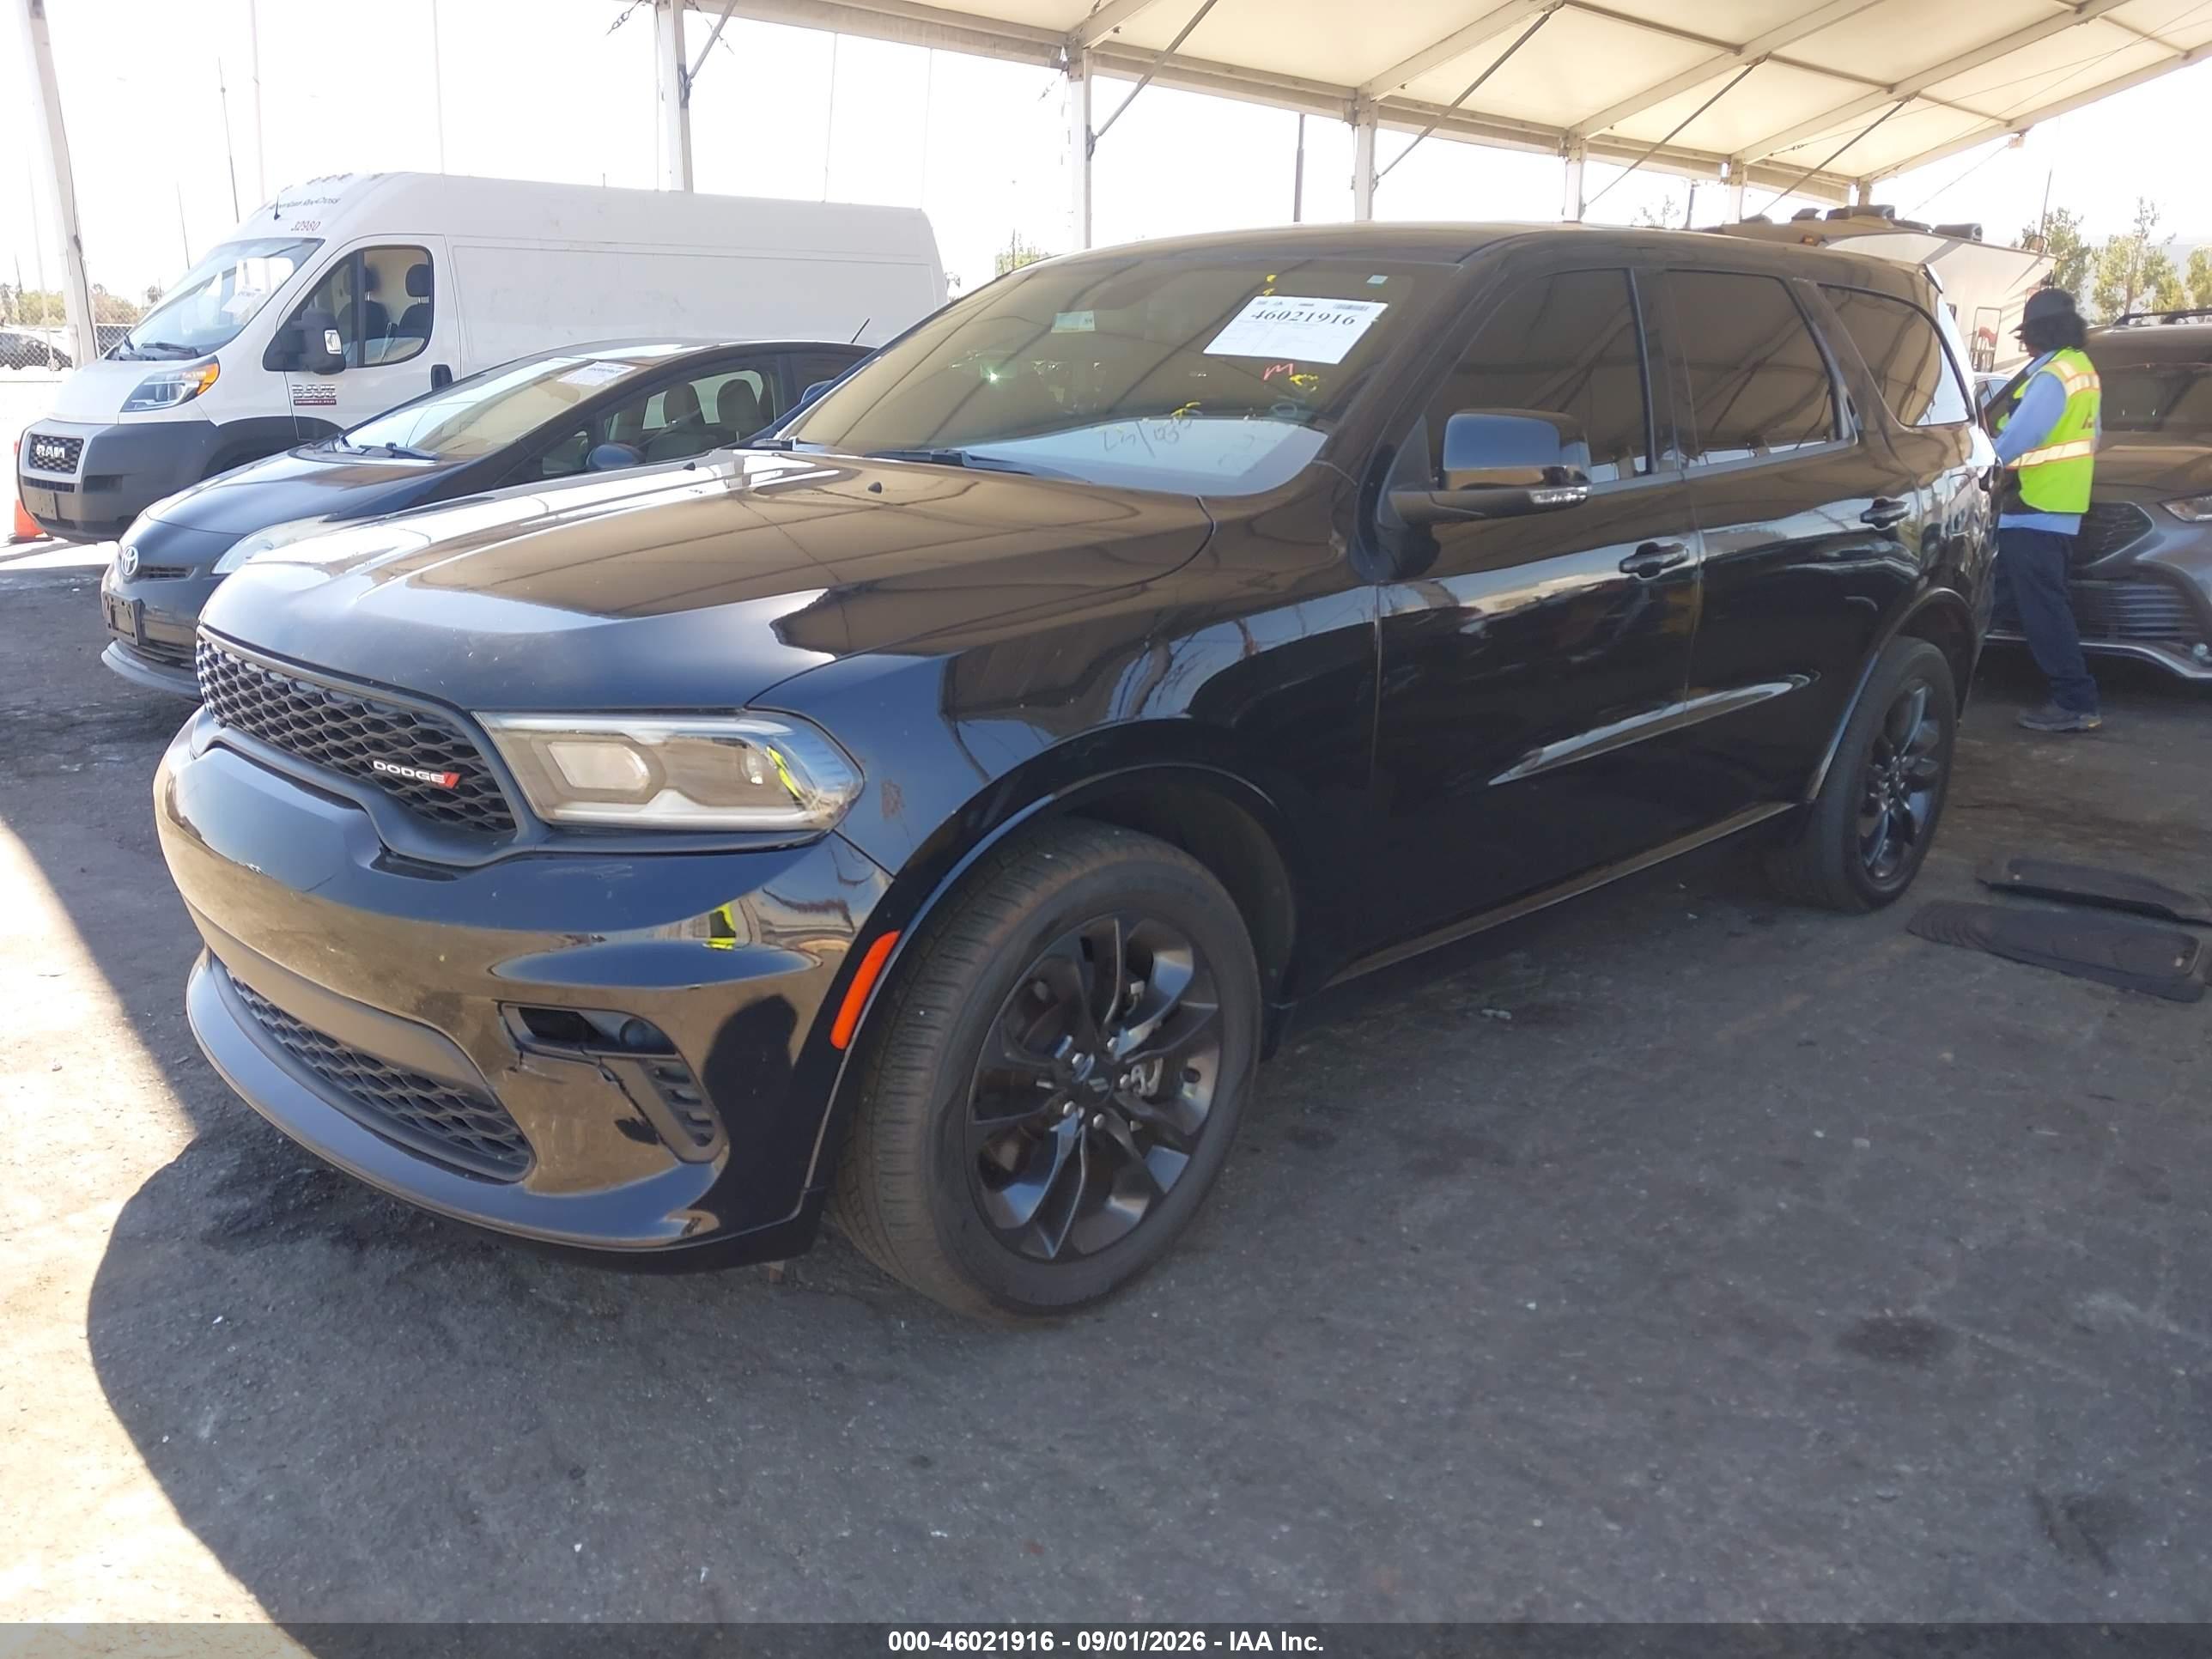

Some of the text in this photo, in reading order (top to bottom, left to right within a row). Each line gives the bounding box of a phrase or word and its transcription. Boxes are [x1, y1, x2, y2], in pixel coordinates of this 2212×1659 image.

[1250, 309, 1356, 325] 46021916
[36, 444, 65, 459] RAM
[373, 760, 446, 784] DODGE
